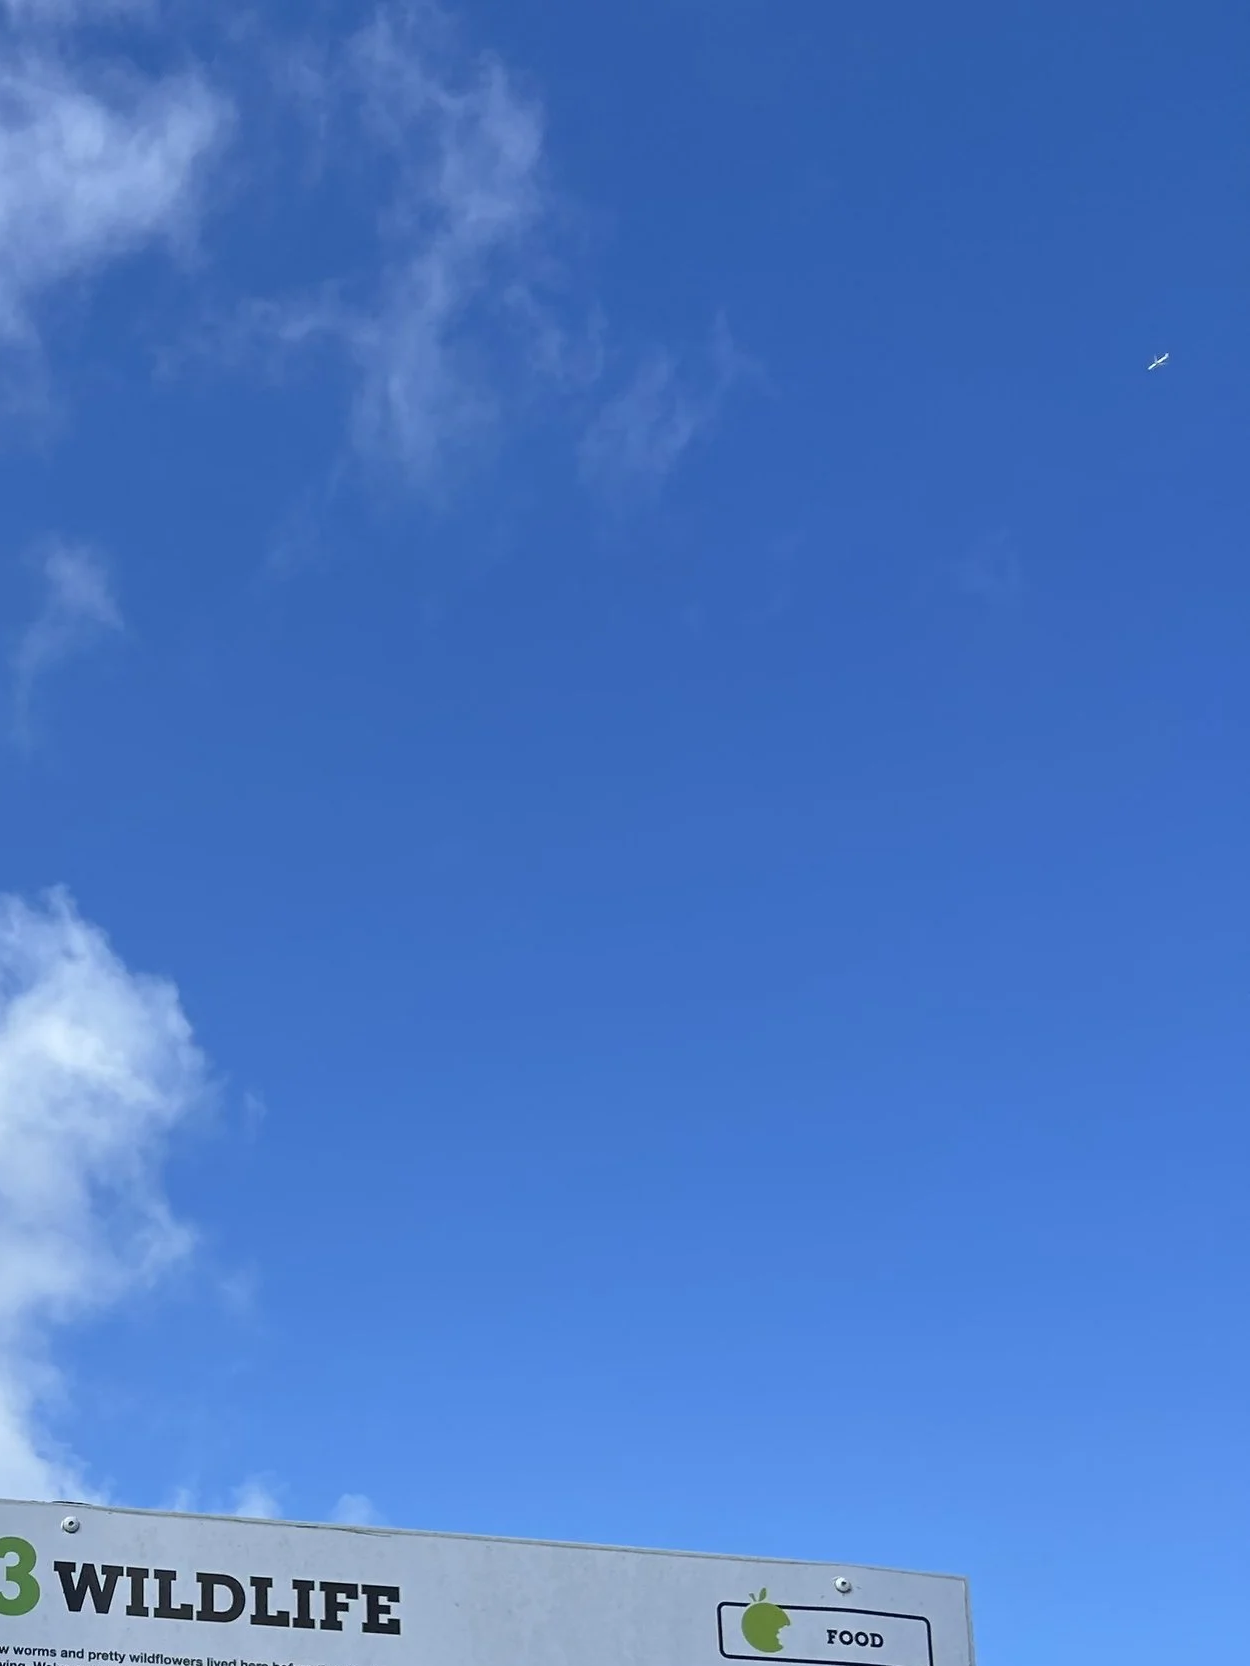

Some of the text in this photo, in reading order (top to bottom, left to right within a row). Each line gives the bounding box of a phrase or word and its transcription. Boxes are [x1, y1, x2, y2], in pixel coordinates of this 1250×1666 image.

[53, 1560, 401, 1635] WILDLIFE
[826, 1629, 883, 1648] FOOD
[12, 1646, 57, 1657] worms
[60, 1648, 84, 1659] and
[88, 1651, 126, 1664] pretty
[129, 1652, 203, 1666] wildflowers
